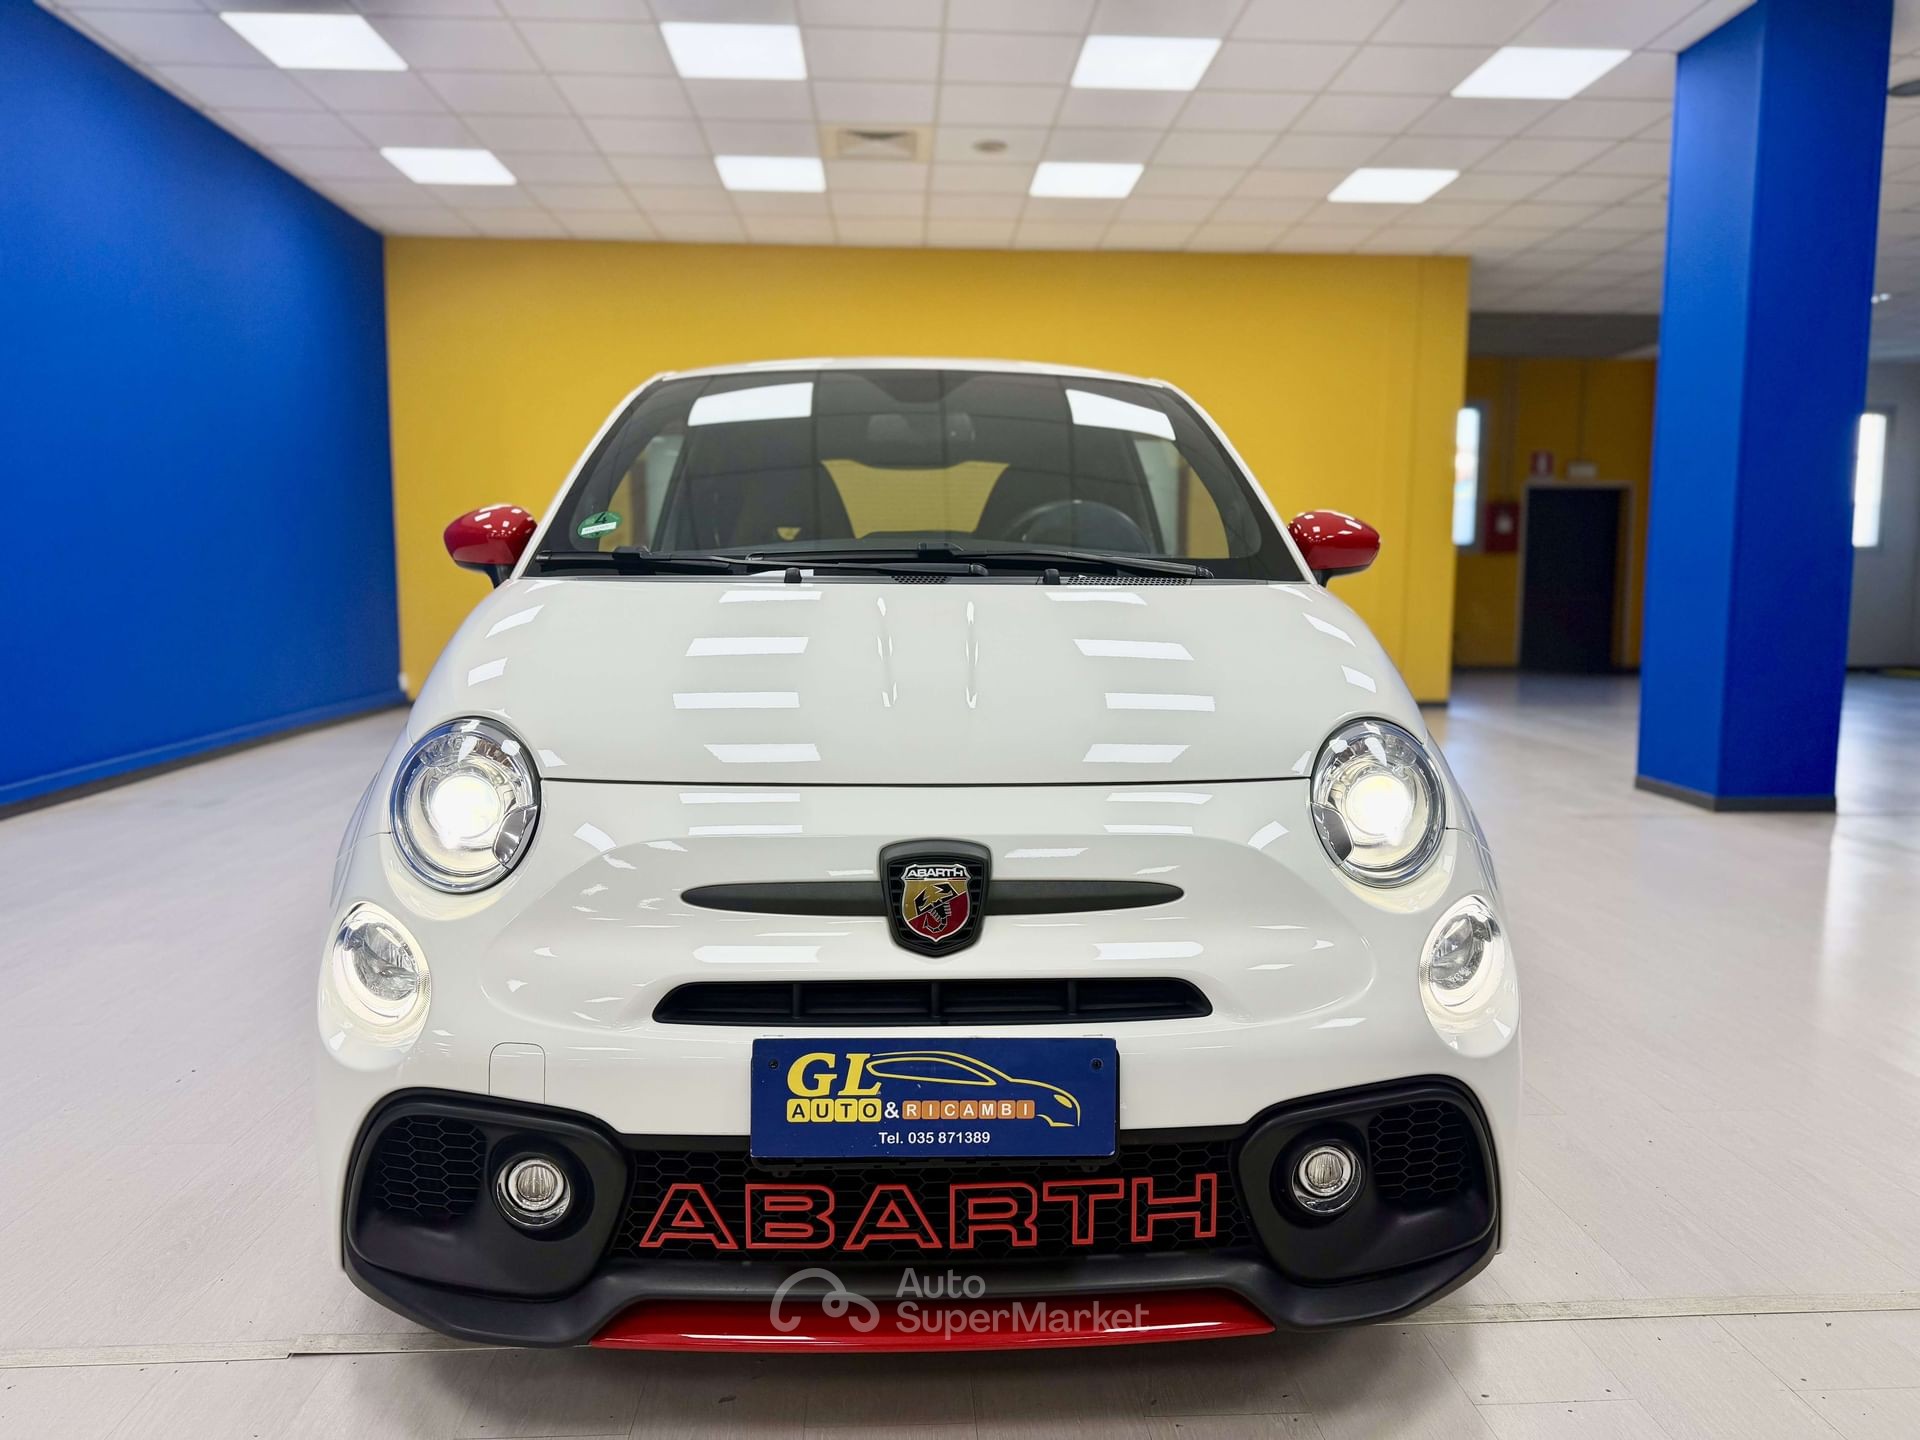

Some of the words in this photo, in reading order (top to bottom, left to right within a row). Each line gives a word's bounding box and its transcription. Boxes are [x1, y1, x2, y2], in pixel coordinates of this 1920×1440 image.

[908, 867, 963, 877] ABARTH
[786, 1052, 882, 1097] GL
[790, 1102, 878, 1120] AUTO
[884, 1102, 900, 1119] &
[905, 1102, 1031, 1118] RICAMBI
[878, 1131, 904, 1145] Tel.
[908, 1131, 934, 1144] 035
[938, 1131, 991, 1144] 871389
[639, 1172, 1218, 1251] ABARTH
